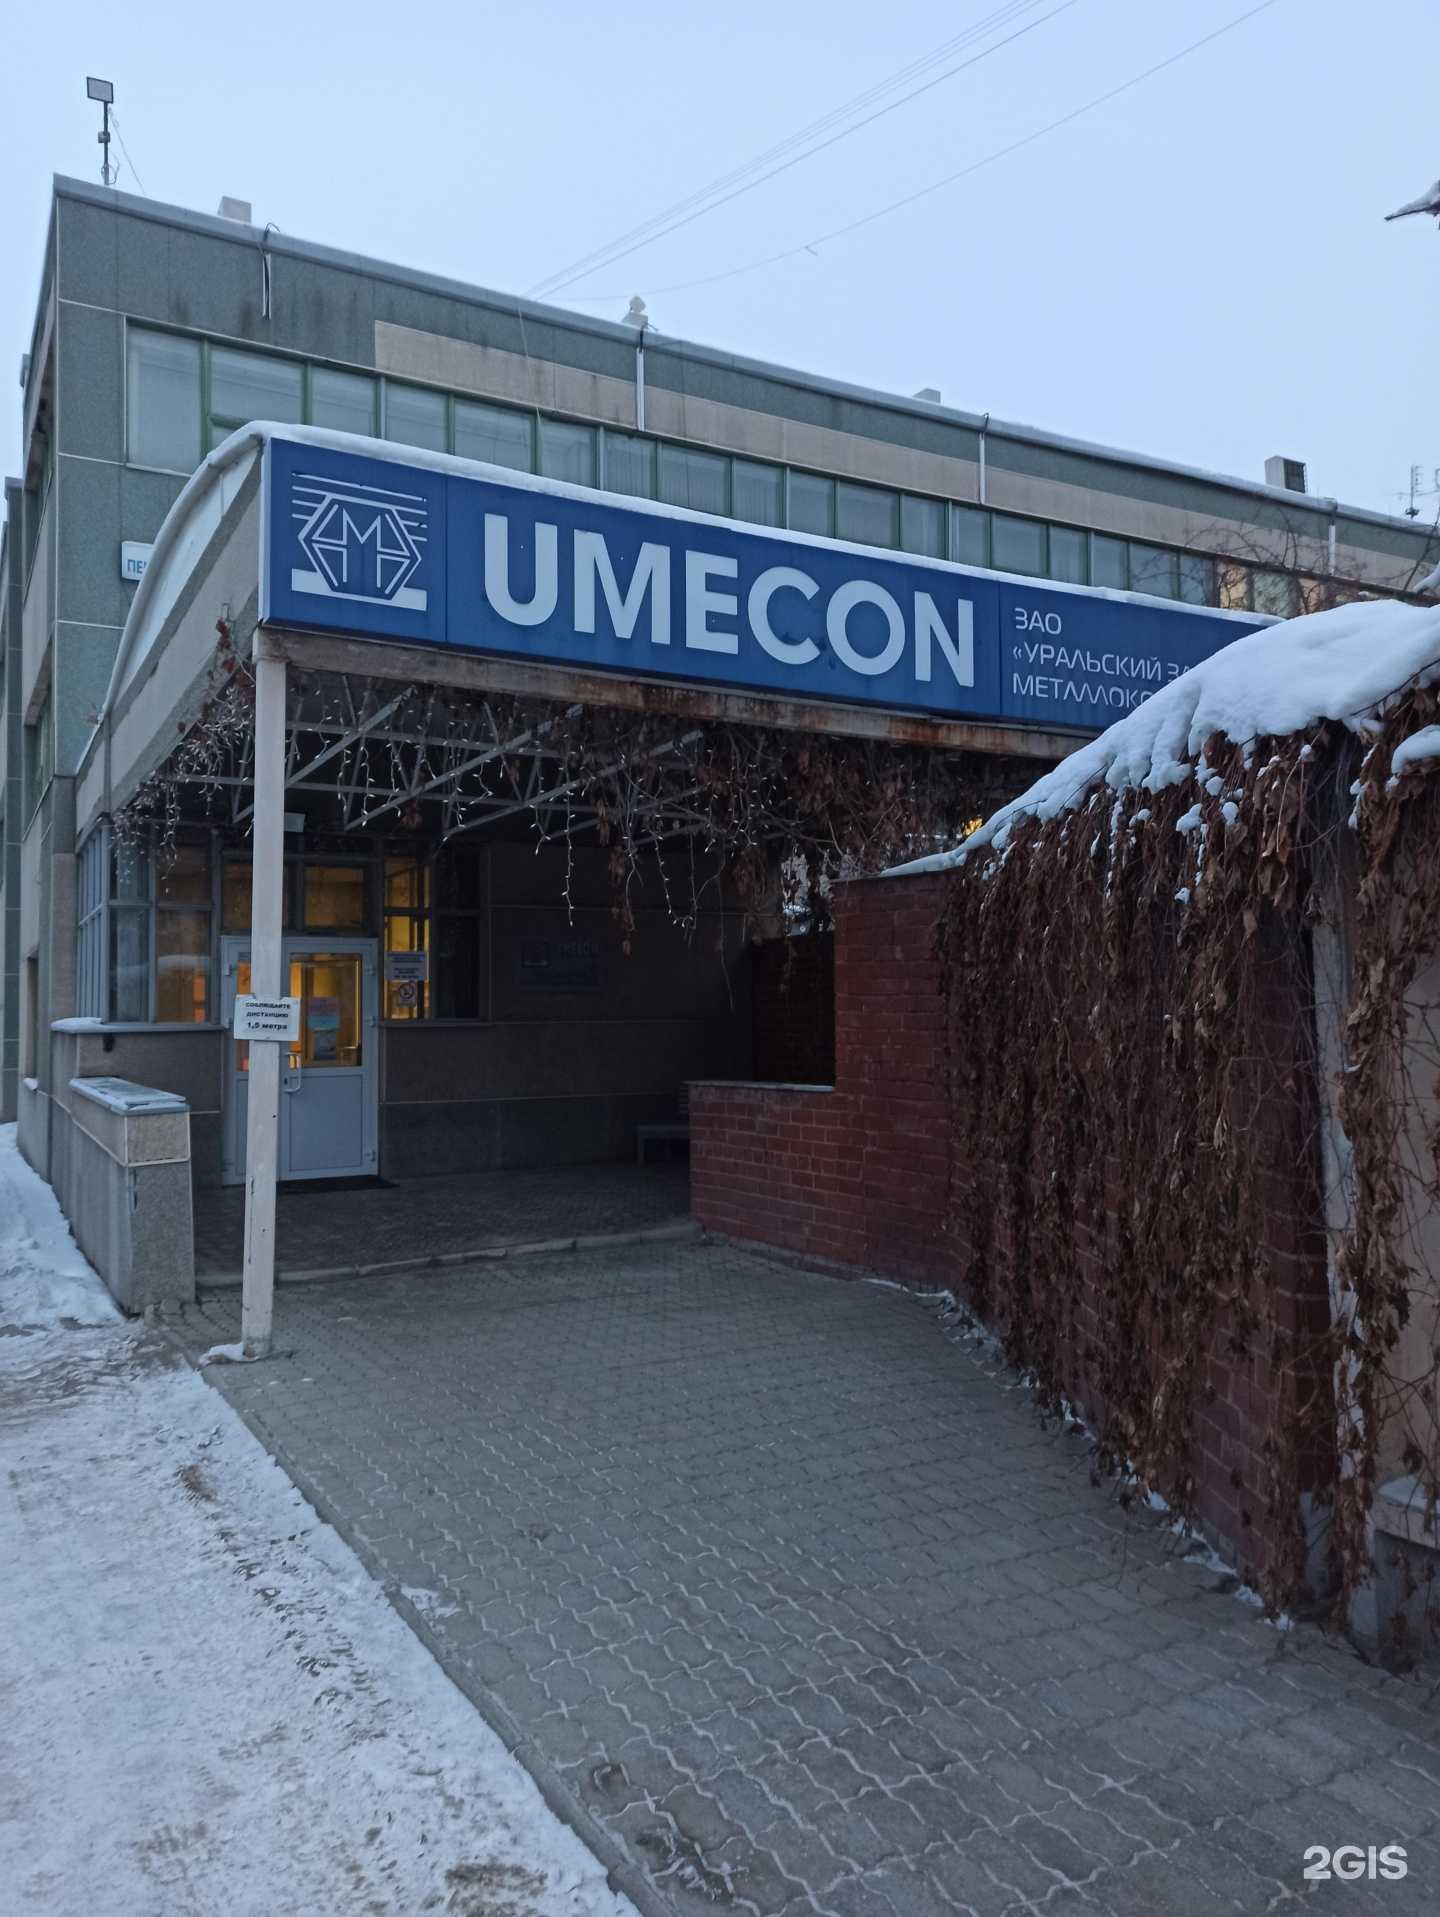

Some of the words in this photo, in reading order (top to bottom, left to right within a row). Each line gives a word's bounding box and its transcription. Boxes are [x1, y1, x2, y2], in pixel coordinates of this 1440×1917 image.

[483, 513, 974, 688] UMECON
[1014, 607, 1062, 635] ЗАО
[1012, 641, 1162, 681] «УРАЛЬСКИЙ
[247, 1021, 260, 1030] 1,5
